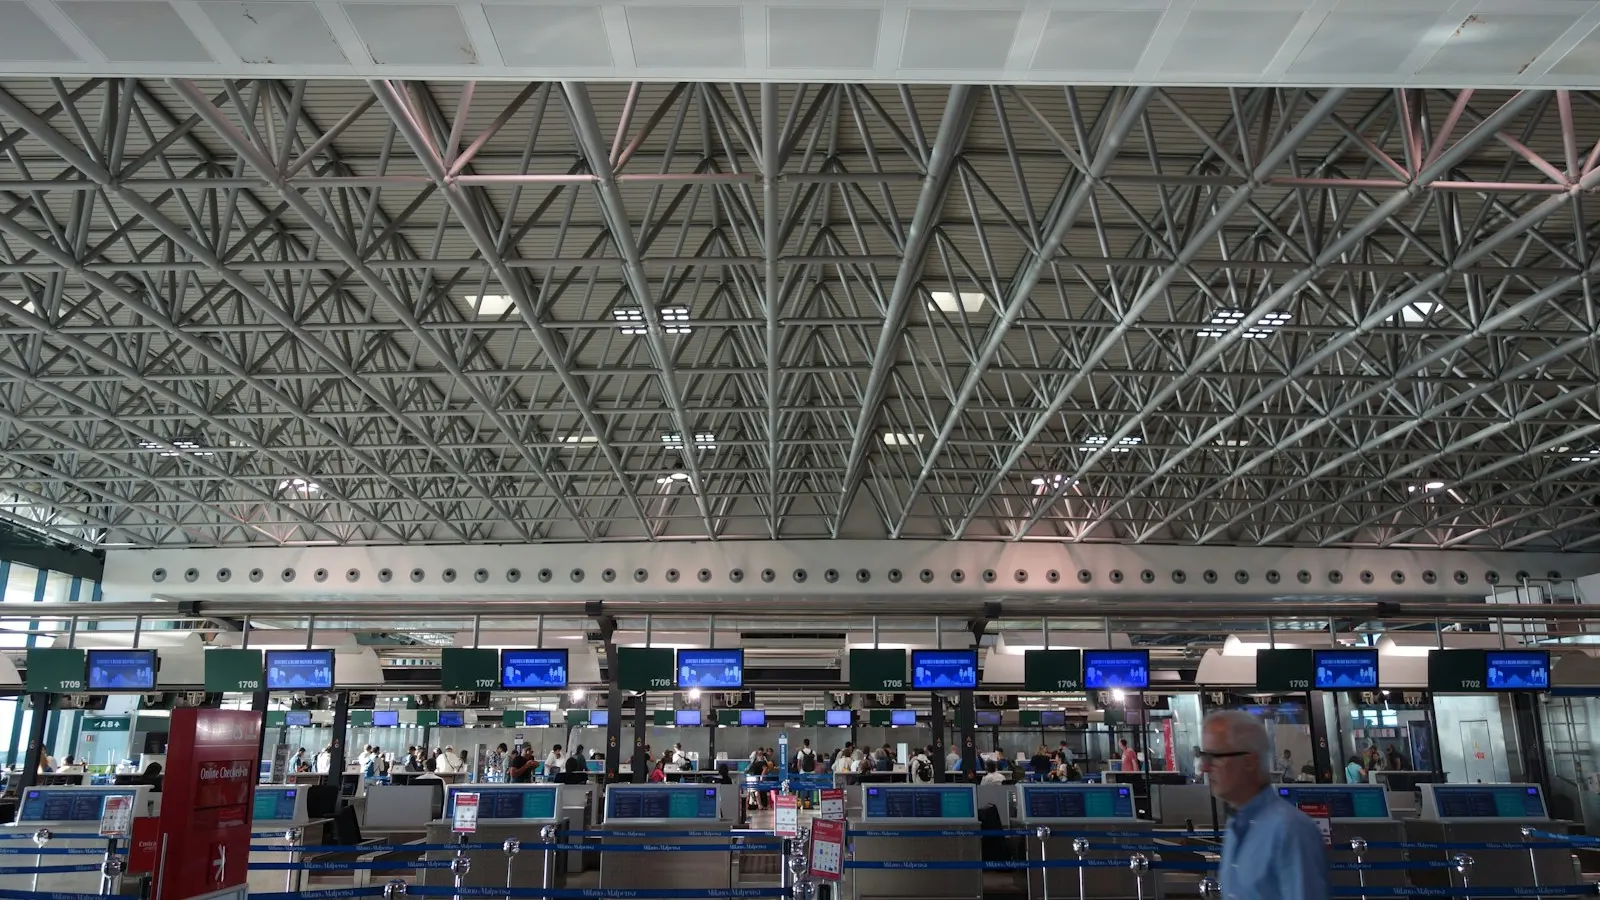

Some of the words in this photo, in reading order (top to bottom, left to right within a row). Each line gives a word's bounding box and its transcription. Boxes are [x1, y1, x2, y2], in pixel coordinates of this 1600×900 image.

[60, 680, 80, 688] 1709
[1461, 680, 1480, 688] 1702
[200, 767, 219, 780] Online
